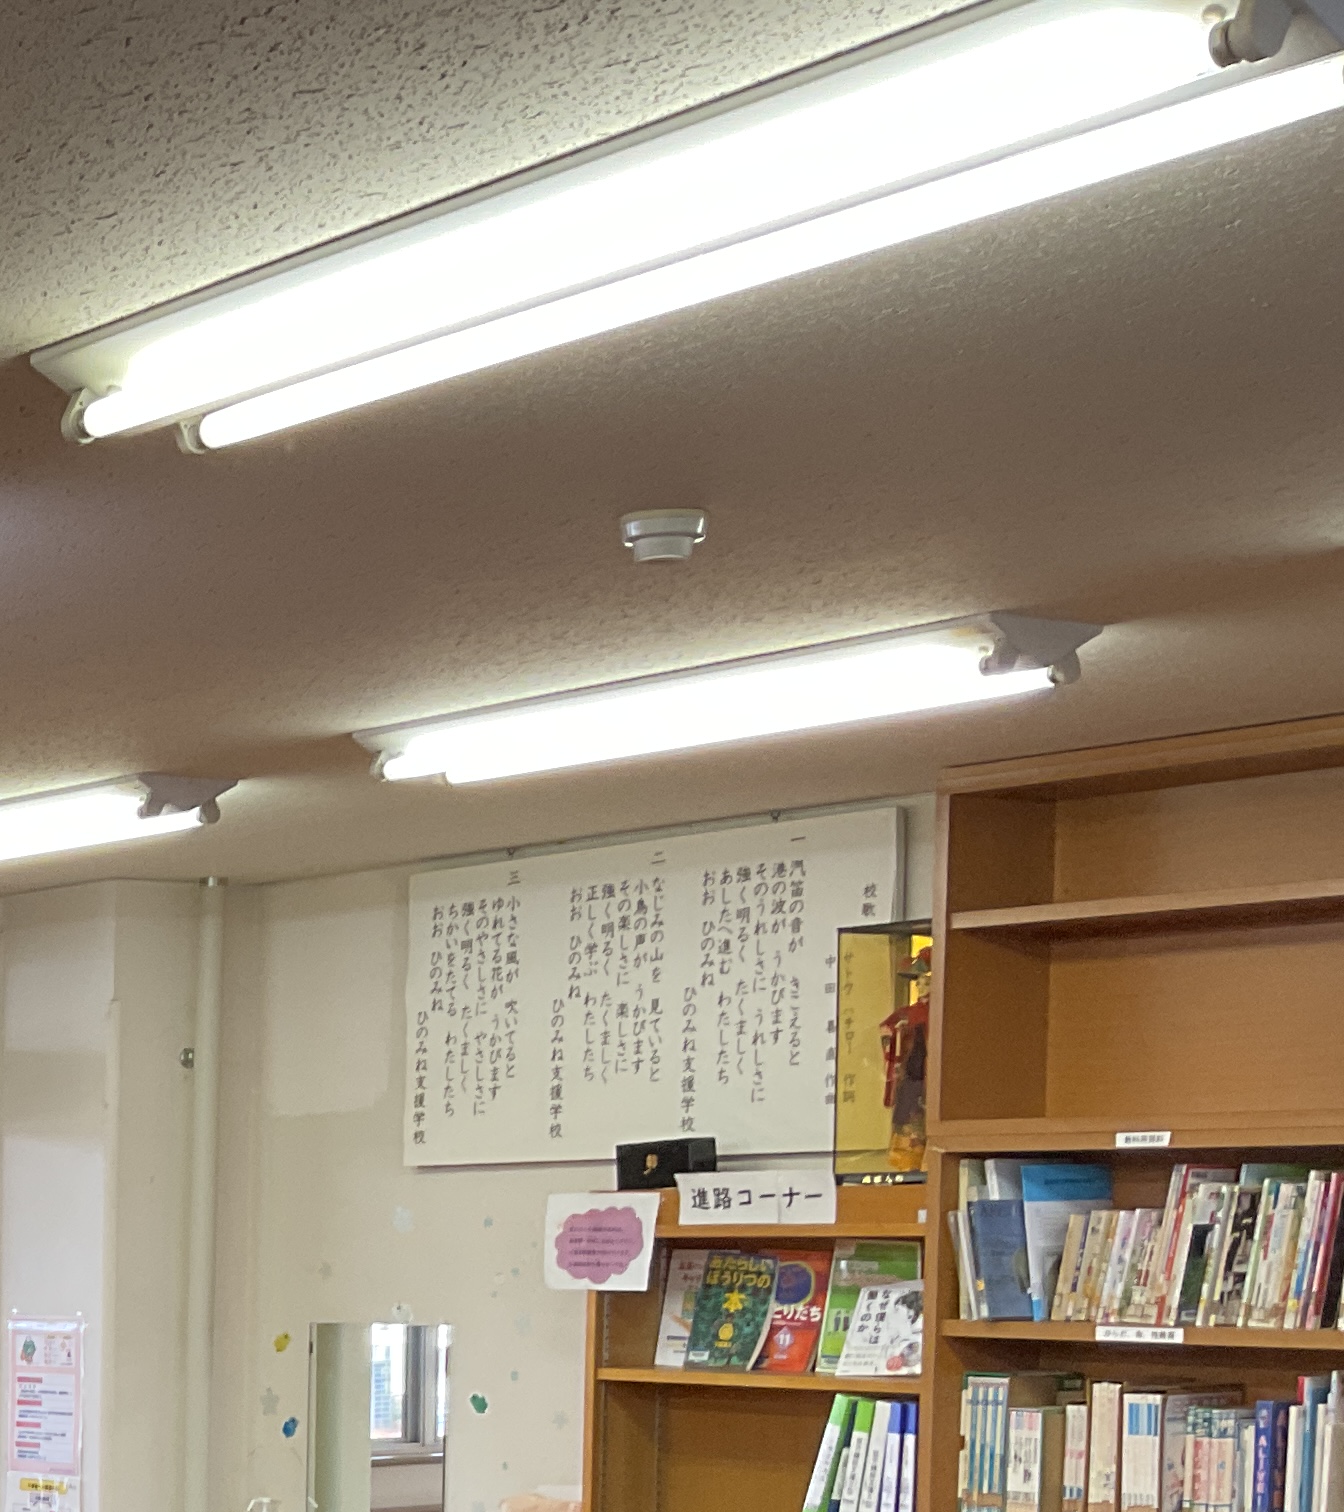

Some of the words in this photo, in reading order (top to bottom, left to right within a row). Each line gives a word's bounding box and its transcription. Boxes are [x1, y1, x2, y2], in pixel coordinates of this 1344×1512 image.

[690, 1186, 823, 1211] 進路コーナー
